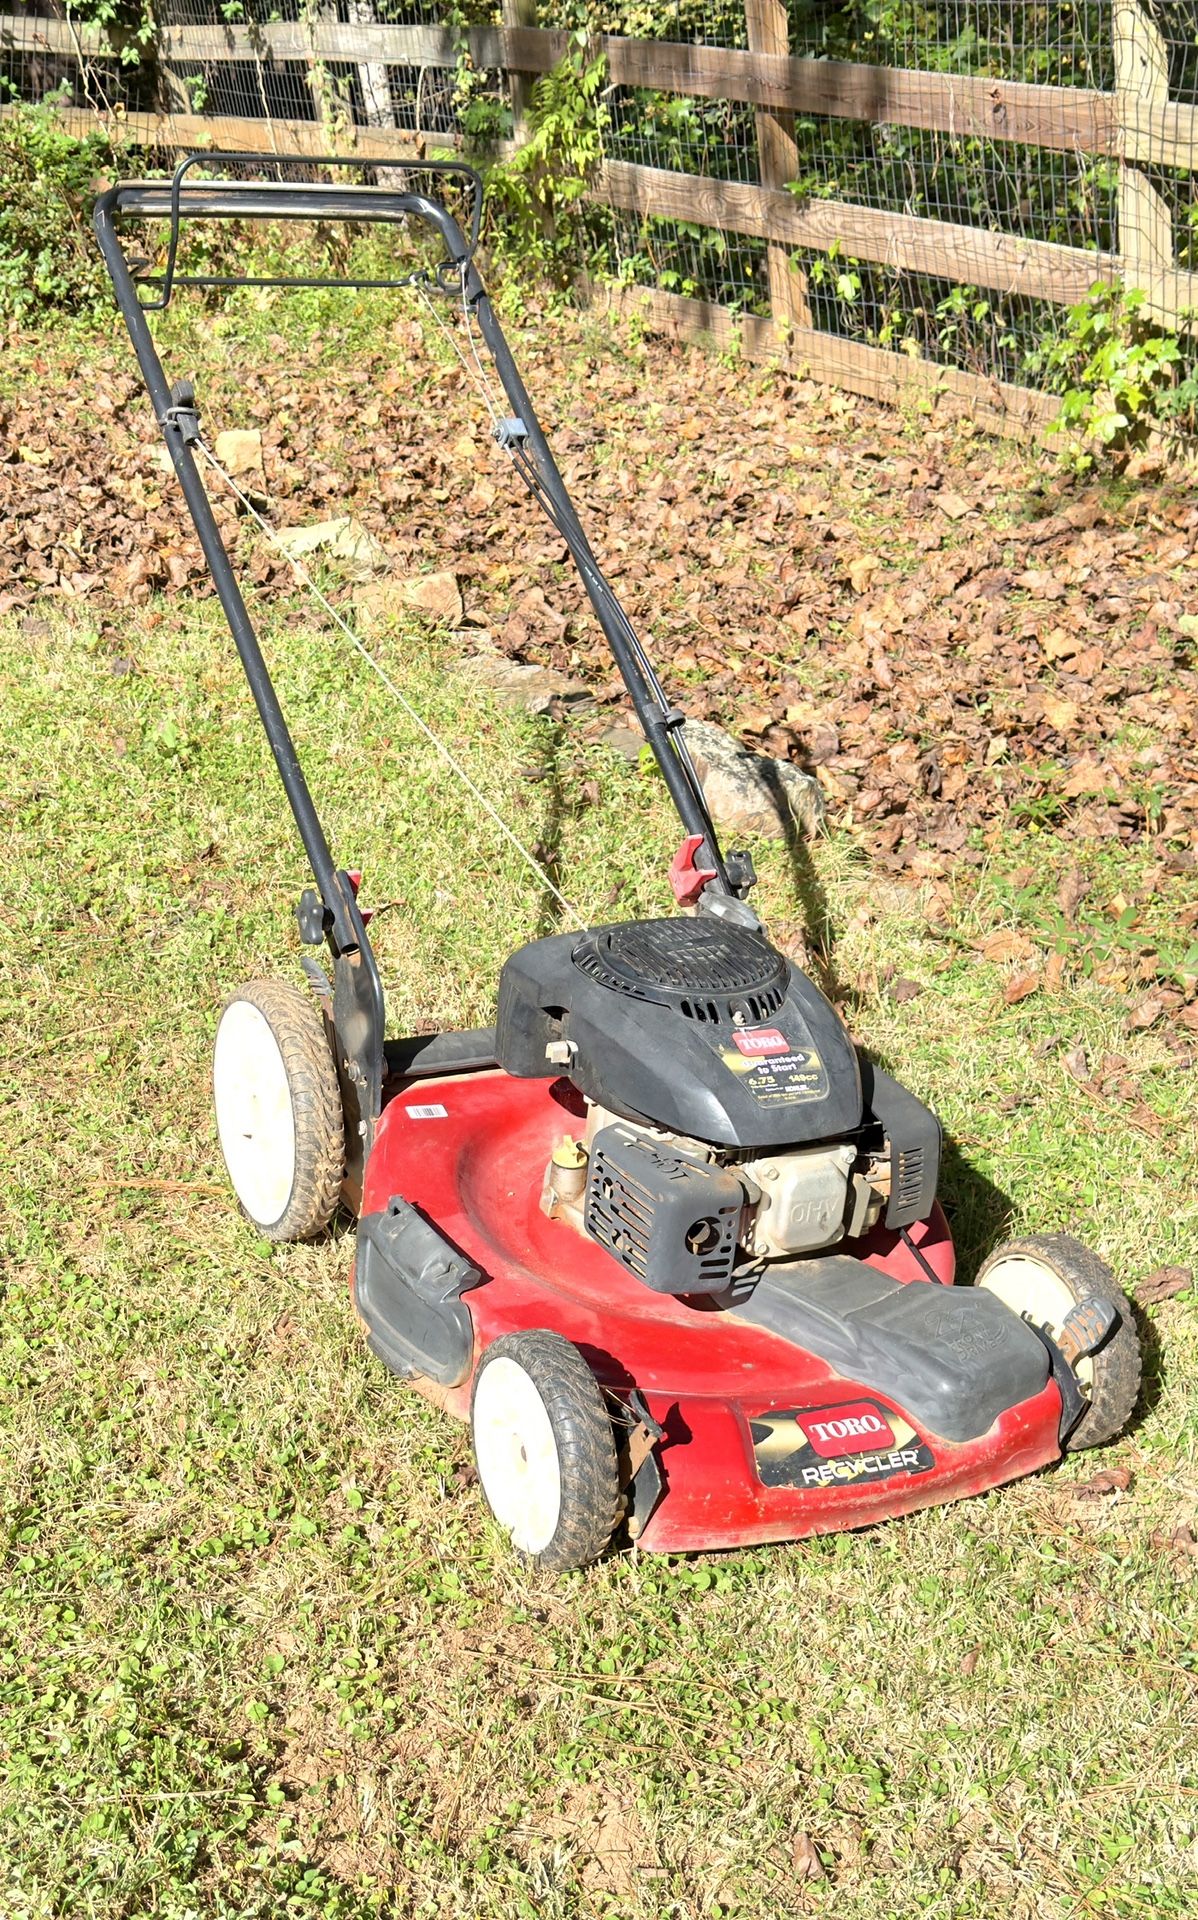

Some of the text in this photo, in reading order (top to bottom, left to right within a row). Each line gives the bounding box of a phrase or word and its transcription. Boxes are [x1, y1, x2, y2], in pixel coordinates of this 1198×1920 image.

[743, 1053, 805, 1066] Guaranteed
[757, 1063, 797, 1074] to Start
[748, 1076, 776, 1085] 6.75
[788, 1074, 818, 1082] 149cc
[791, 1197, 840, 1223] OHV
